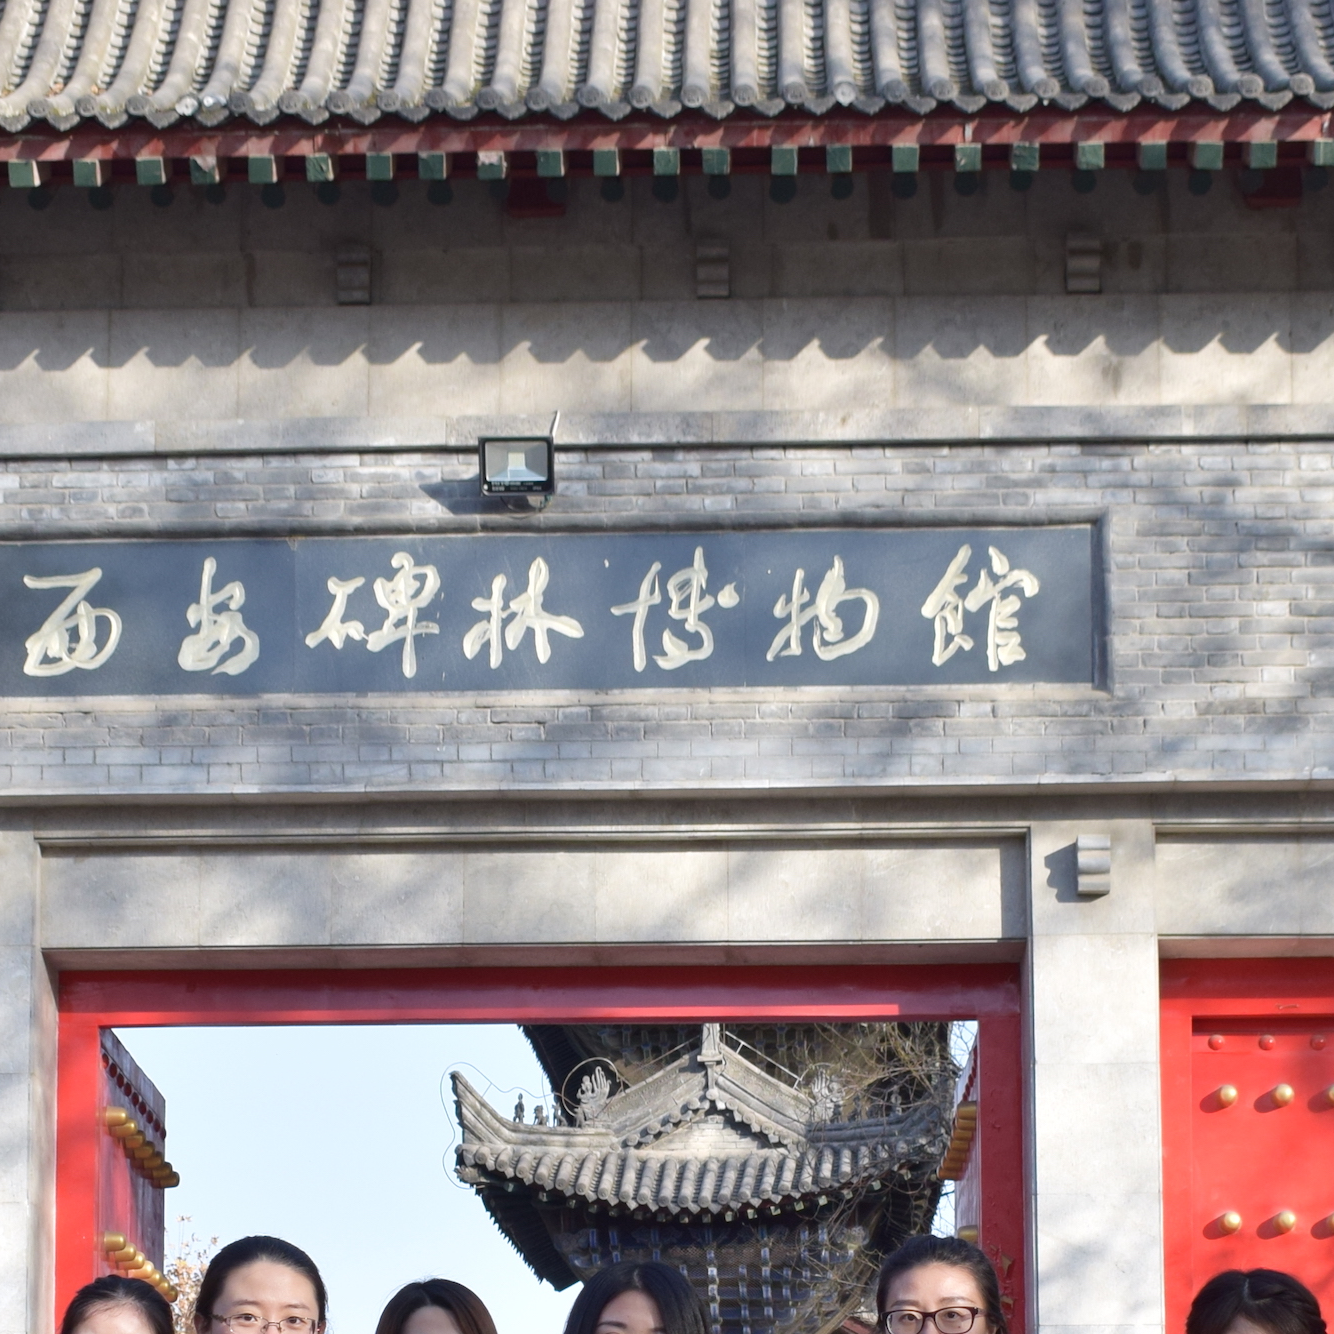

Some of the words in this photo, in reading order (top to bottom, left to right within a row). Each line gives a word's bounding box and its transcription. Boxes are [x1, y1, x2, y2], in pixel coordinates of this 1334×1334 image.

[23, 546, 1039, 678] 西安碑林博物館
